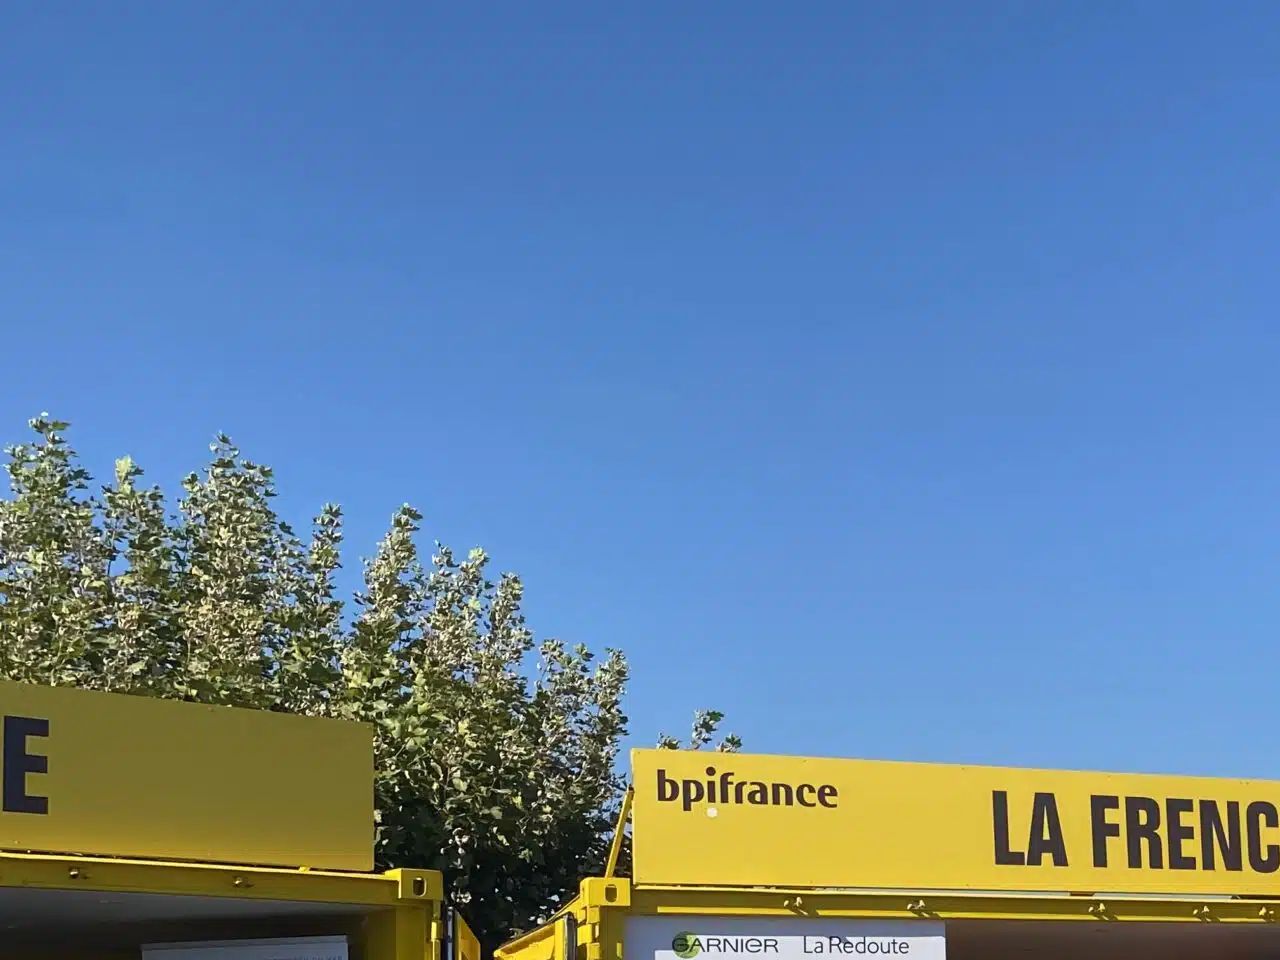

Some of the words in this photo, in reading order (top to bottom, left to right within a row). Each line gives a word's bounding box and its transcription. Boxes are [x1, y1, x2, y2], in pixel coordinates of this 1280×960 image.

[657, 766, 838, 811] bpifrance
[992, 789, 1069, 868] LA
[672, 937, 779, 954] GARNIER
[803, 936, 824, 954] La
[829, 936, 910, 954] Redoute
